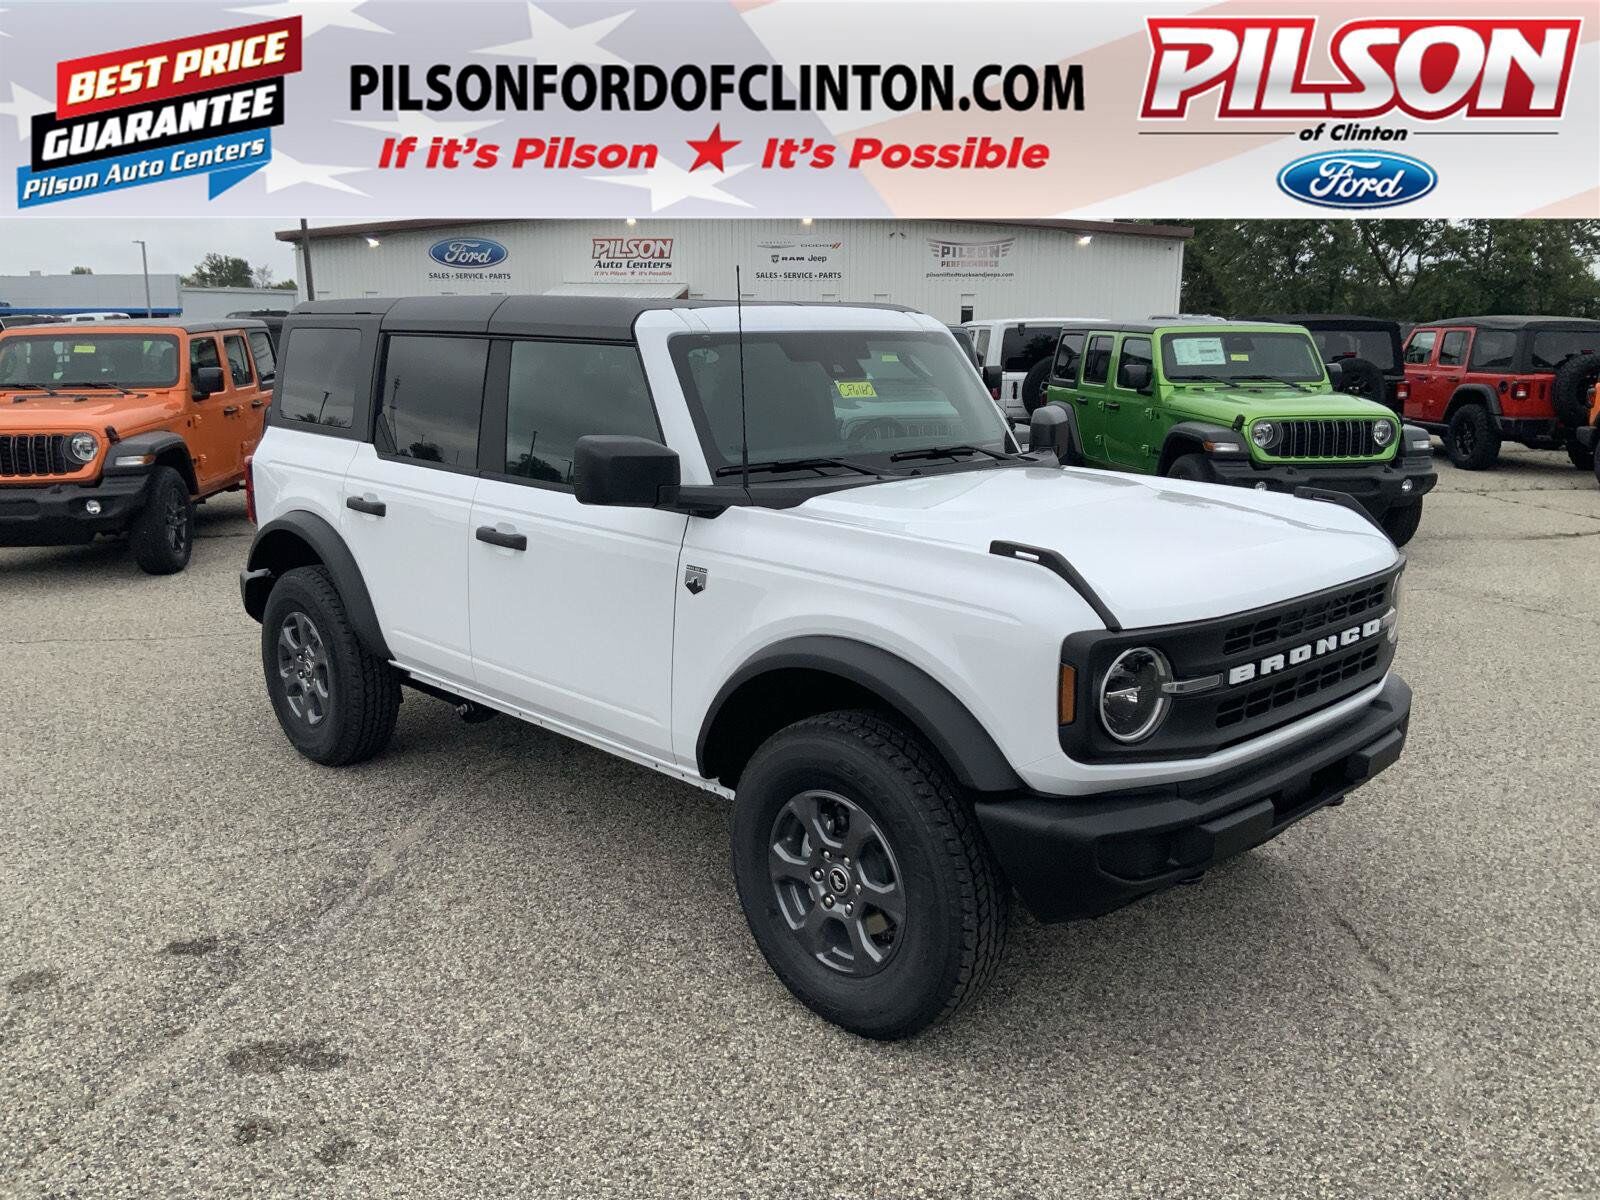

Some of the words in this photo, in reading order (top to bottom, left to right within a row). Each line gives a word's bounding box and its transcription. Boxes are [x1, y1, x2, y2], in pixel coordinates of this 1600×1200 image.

[445, 242, 493, 263] Ford
[592, 239, 673, 259] PILSON
[941, 245, 1000, 258] PILSON
[594, 260, 623, 269] Auto
[626, 260, 673, 269] Centers
[807, 254, 827, 263] Jeep
[455, 272, 484, 280] SERVICE
[1228, 618, 1381, 685] BRONCO
